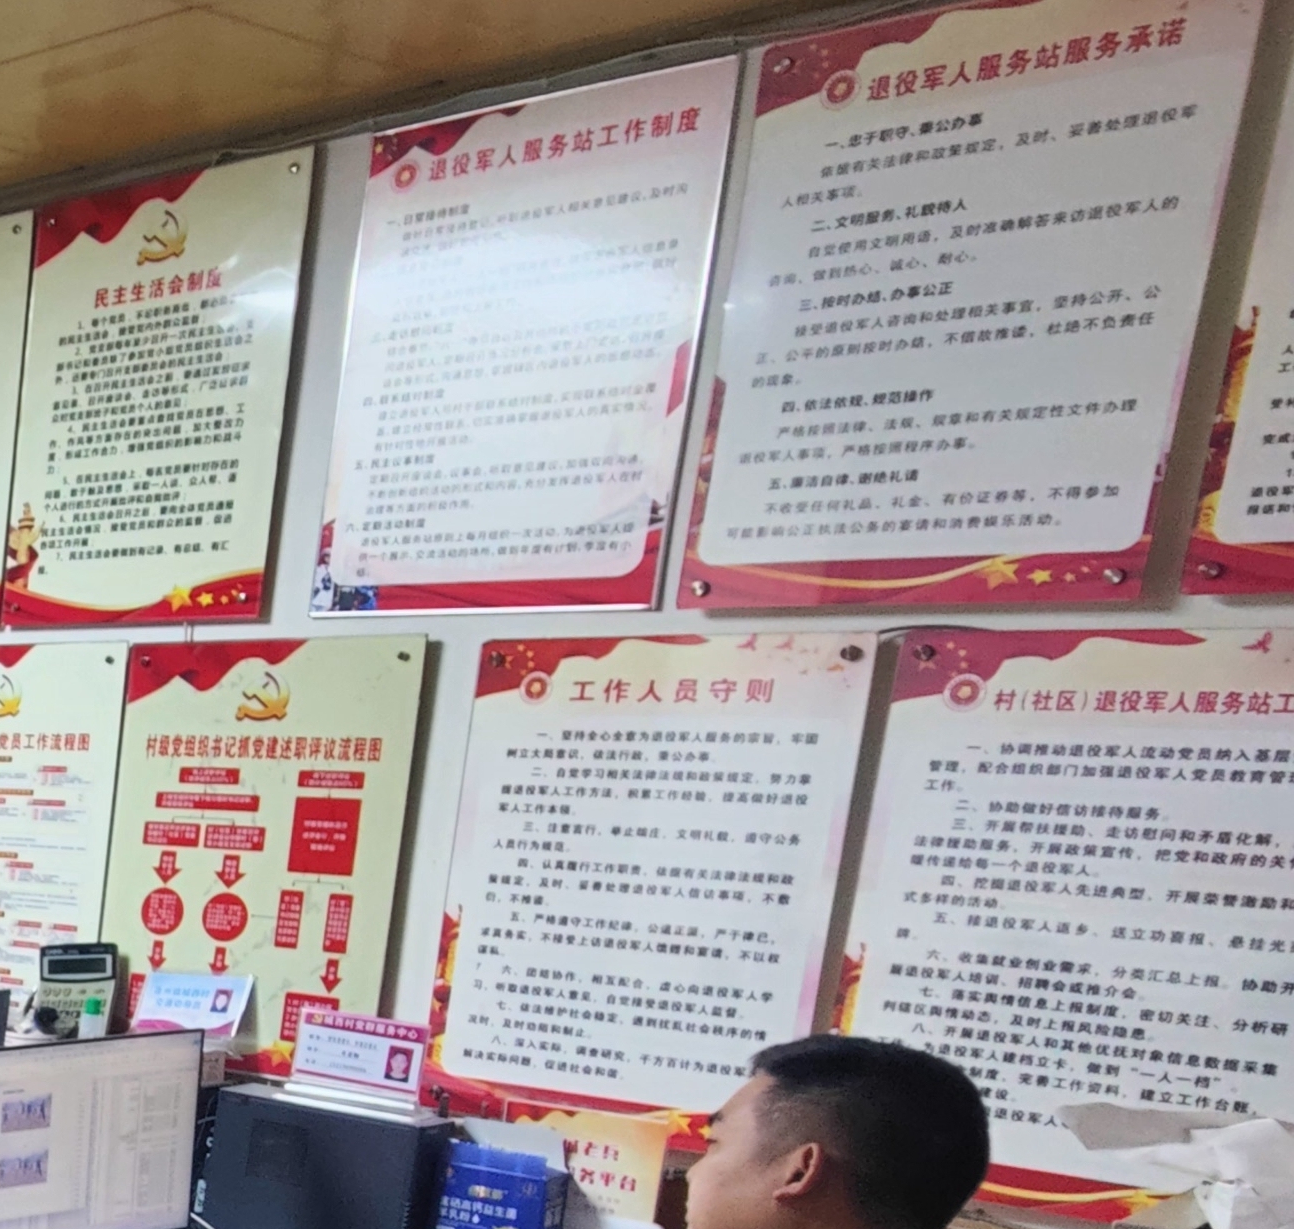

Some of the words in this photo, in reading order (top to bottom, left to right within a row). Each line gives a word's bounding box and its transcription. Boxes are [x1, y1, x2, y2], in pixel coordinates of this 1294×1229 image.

[866, 17, 1188, 101] 退役军人服务站服务承诺
[428, 107, 702, 182] 退役军人服务站工作制度
[93, 265, 223, 310] 民主生活会制度
[569, 678, 776, 704] 工作人员守则
[145, 733, 383, 763] 村级党组织书记抓党建述职评议流程图
[967, 742, 1294, 765] 一、协调推动退役军人流动党员纳入基层
[925, 777, 965, 794] 工作。
[933, 911, 1294, 953] 五、接退役军人返乡、送立功喜报、悬挂光
[322, 1014, 419, 1039] 城西村党群服务中心
